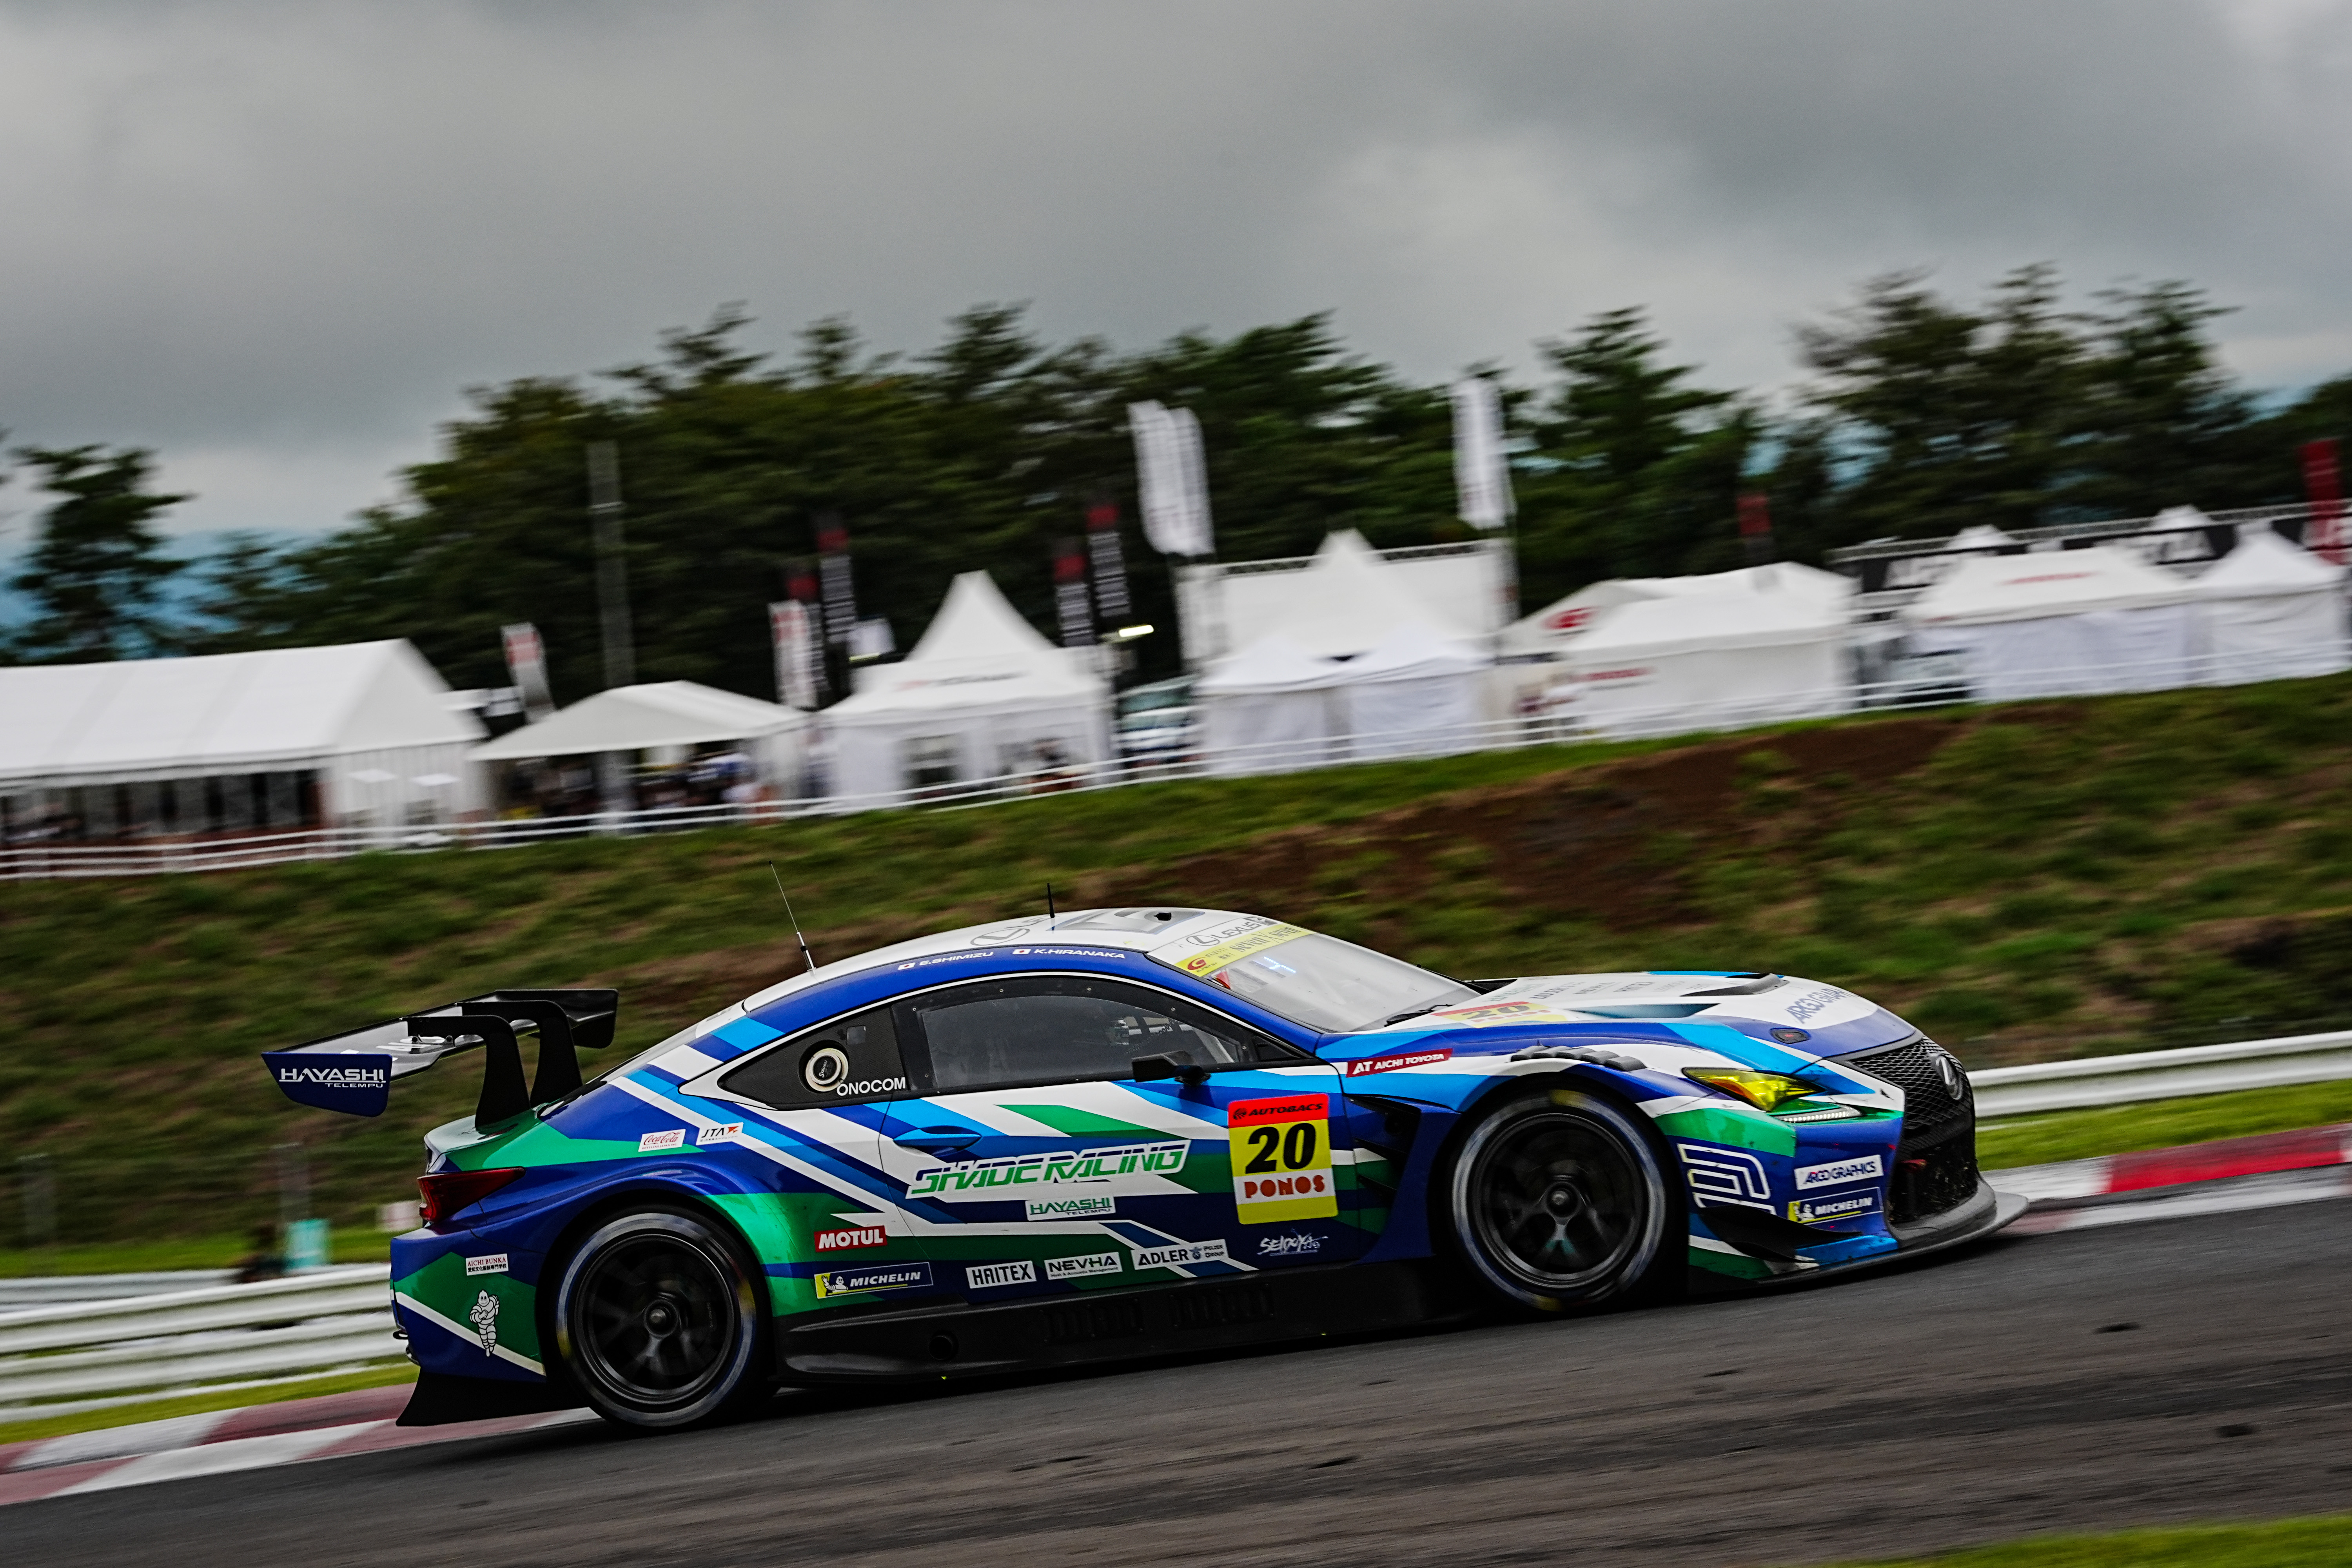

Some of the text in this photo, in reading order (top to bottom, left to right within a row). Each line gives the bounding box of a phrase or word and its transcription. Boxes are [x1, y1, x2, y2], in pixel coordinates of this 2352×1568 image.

[1212, 922, 1262, 938] LEXUS
[919, 951, 993, 966] E.SHIMIZU
[1034, 949, 1125, 959] K.HIRANAKA
[1461, 1005, 1530, 1019] 20
[1352, 1054, 1444, 1074] AT AICHI TOYOTA
[279, 1068, 386, 1082] HAYASHI
[837, 1077, 906, 1096] ONOCOM
[1249, 1103, 1323, 1116] AUTOBACS
[701, 1127, 725, 1138] JTA
[1245, 1123, 1316, 1174] 20
[1044, 1144, 1186, 1181] RACING
[1244, 1175, 1325, 1198] PONOS
[1029, 1197, 1112, 1215] HAYASHI
[1815, 1197, 1873, 1215] MICHELIN
[818, 1229, 883, 1249] MOTUL
[1049, 1256, 1117, 1272] NEVHA
[1138, 1249, 1189, 1266] ADLER
[850, 1272, 921, 1287] MICHELIN
[972, 1264, 1032, 1285] HAITEX
